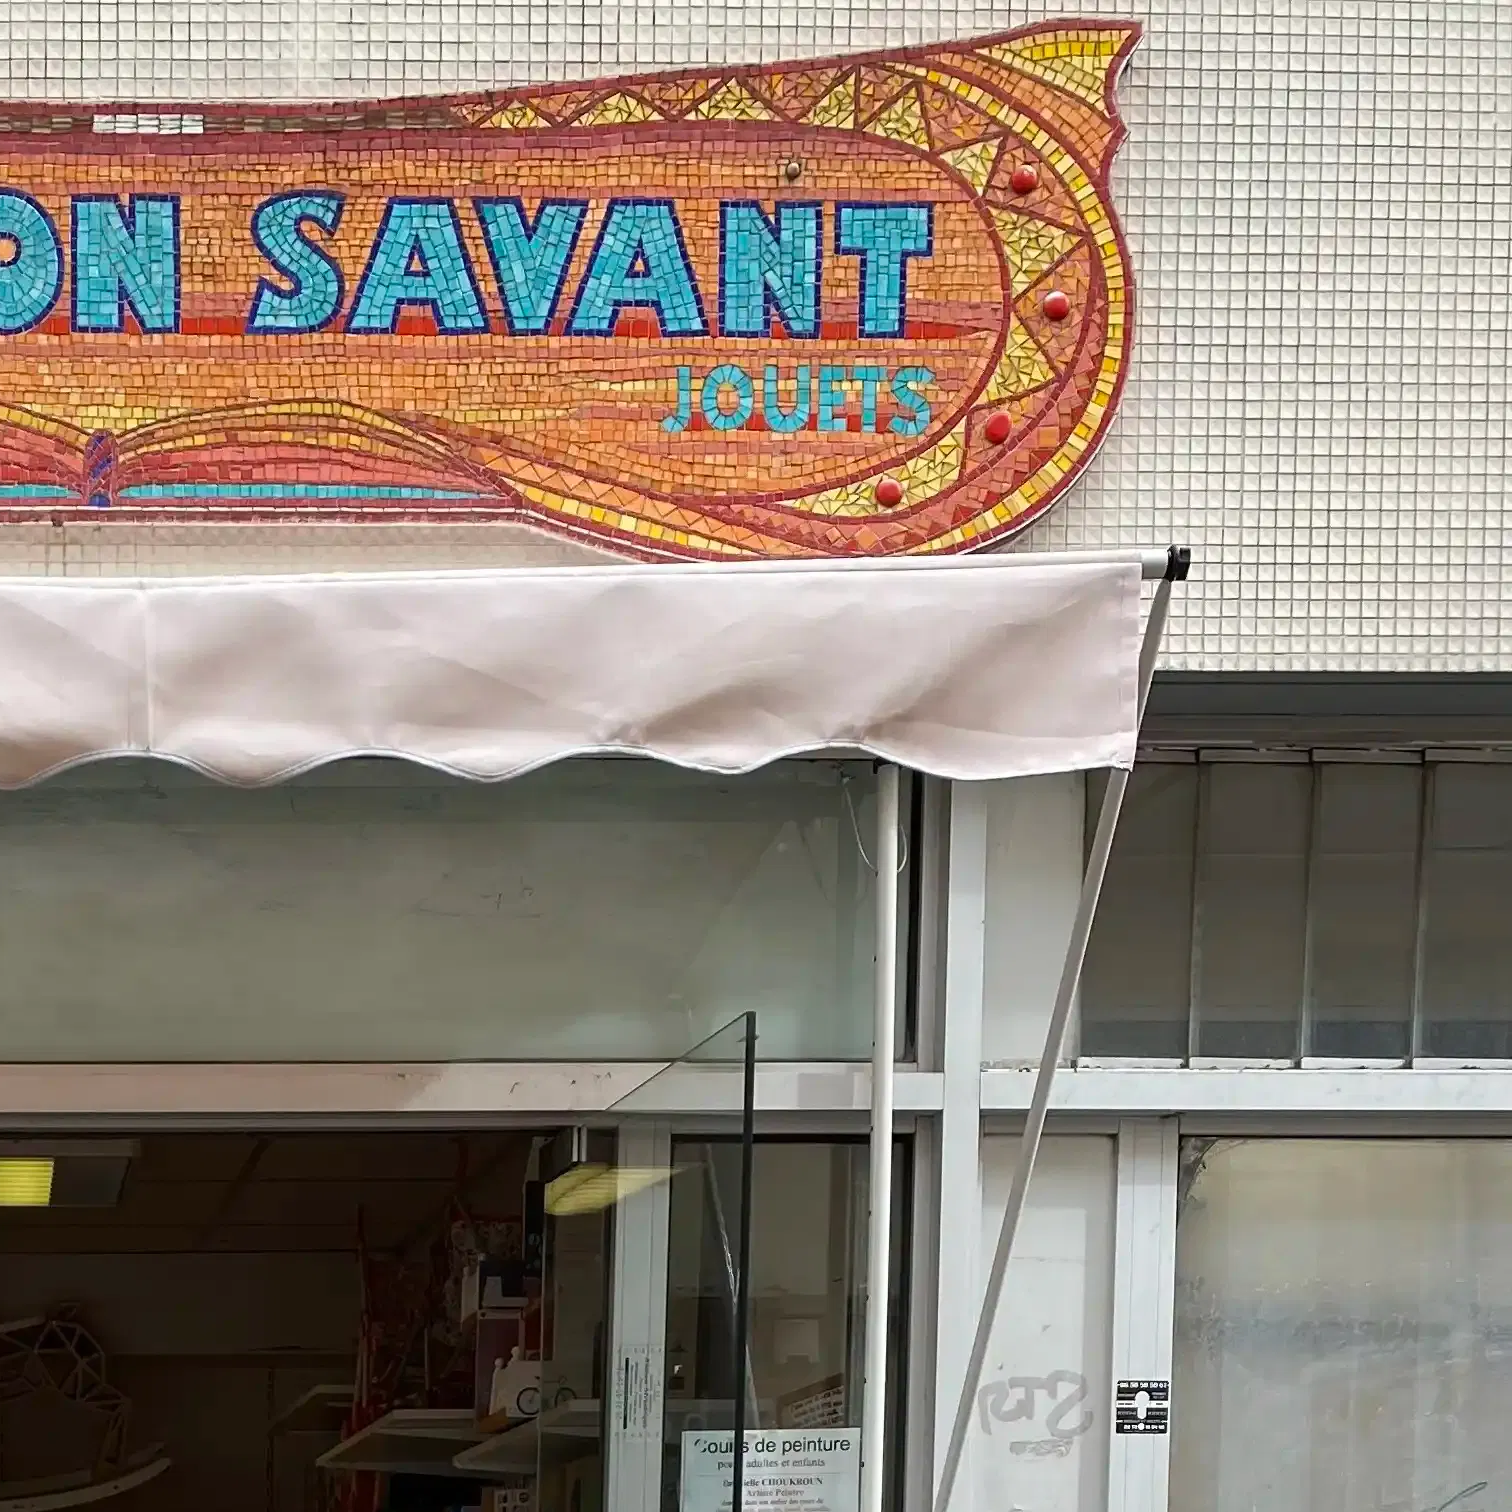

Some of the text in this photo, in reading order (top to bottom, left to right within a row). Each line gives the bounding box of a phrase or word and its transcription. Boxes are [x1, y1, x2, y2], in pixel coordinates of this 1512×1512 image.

[249, 189, 934, 338] SAVANT
[662, 363, 937, 435] JOUETS
[755, 1438, 776, 1453] de
[782, 1437, 851, 1456] peinture
[792, 1457, 825, 1467] enfants
